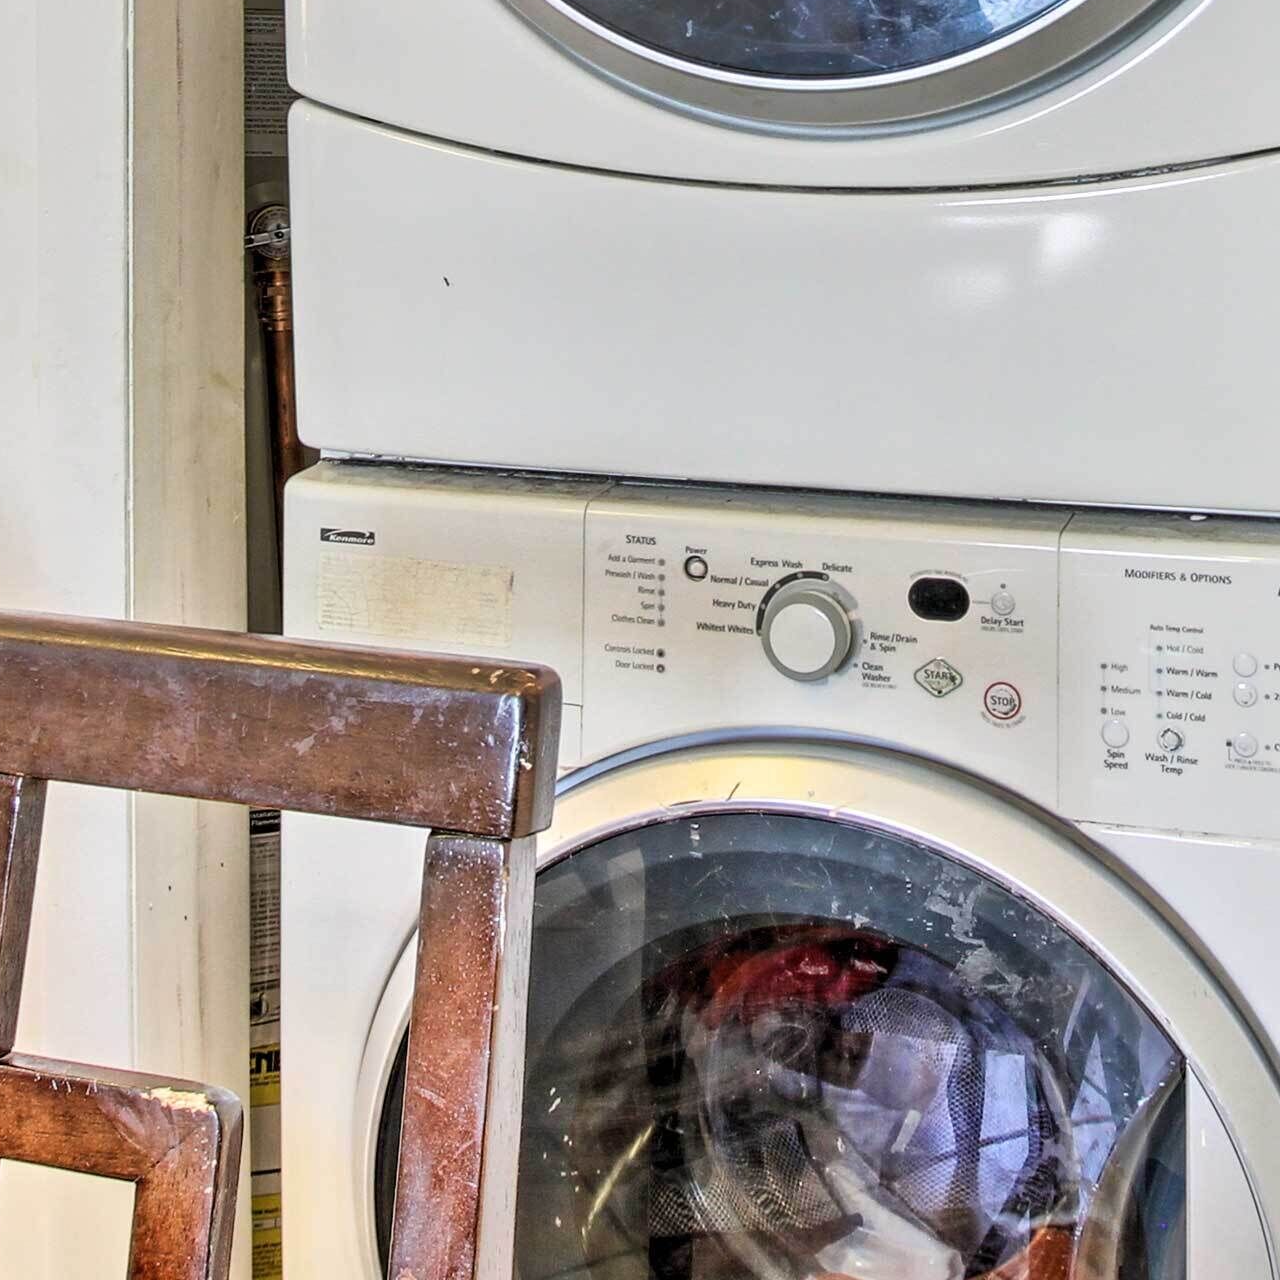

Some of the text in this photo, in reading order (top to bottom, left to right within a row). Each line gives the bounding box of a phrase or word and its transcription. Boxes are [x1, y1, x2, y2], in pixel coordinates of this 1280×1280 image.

[329, 533, 375, 545] Kenmore
[625, 534, 656, 545] STATUS
[685, 546, 707, 555] Power
[750, 557, 803, 569] Express Wash
[822, 562, 853, 573] Delicate
[710, 575, 738, 585] Normal
[744, 577, 769, 587] Casual
[1124, 569, 1232, 585] MODIFIERS & OPTIONS
[712, 598, 756, 611] Heavy Duty
[981, 616, 1024, 627] Delay Start
[696, 621, 754, 634] Whitest Whites
[1165, 625, 1180, 633] Temp
[870, 642, 896, 653] & Spin
[1166, 644, 1180, 652] Hot
[1186, 645, 1204, 654] Cold
[862, 661, 884, 671] Clean
[1111, 663, 1128, 673] High
[861, 672, 891, 682] Washer
[1166, 667, 1188, 676] Warm
[1195, 669, 1218, 678] Warm
[1111, 685, 1141, 695] Medium
[1166, 689, 1188, 698] Warm
[1195, 691, 1212, 700] Cold
[990, 695, 1015, 706] STOP
[1110, 707, 1126, 716] Low
[1166, 711, 1182, 720] Cold
[1189, 713, 1206, 722] Cold
[1107, 749, 1125, 759] Spin
[1145, 752, 1168, 762] Wash
[1176, 755, 1198, 765] Rinse
[1104, 759, 1128, 770] Speed
[1160, 764, 1183, 776] Temp
